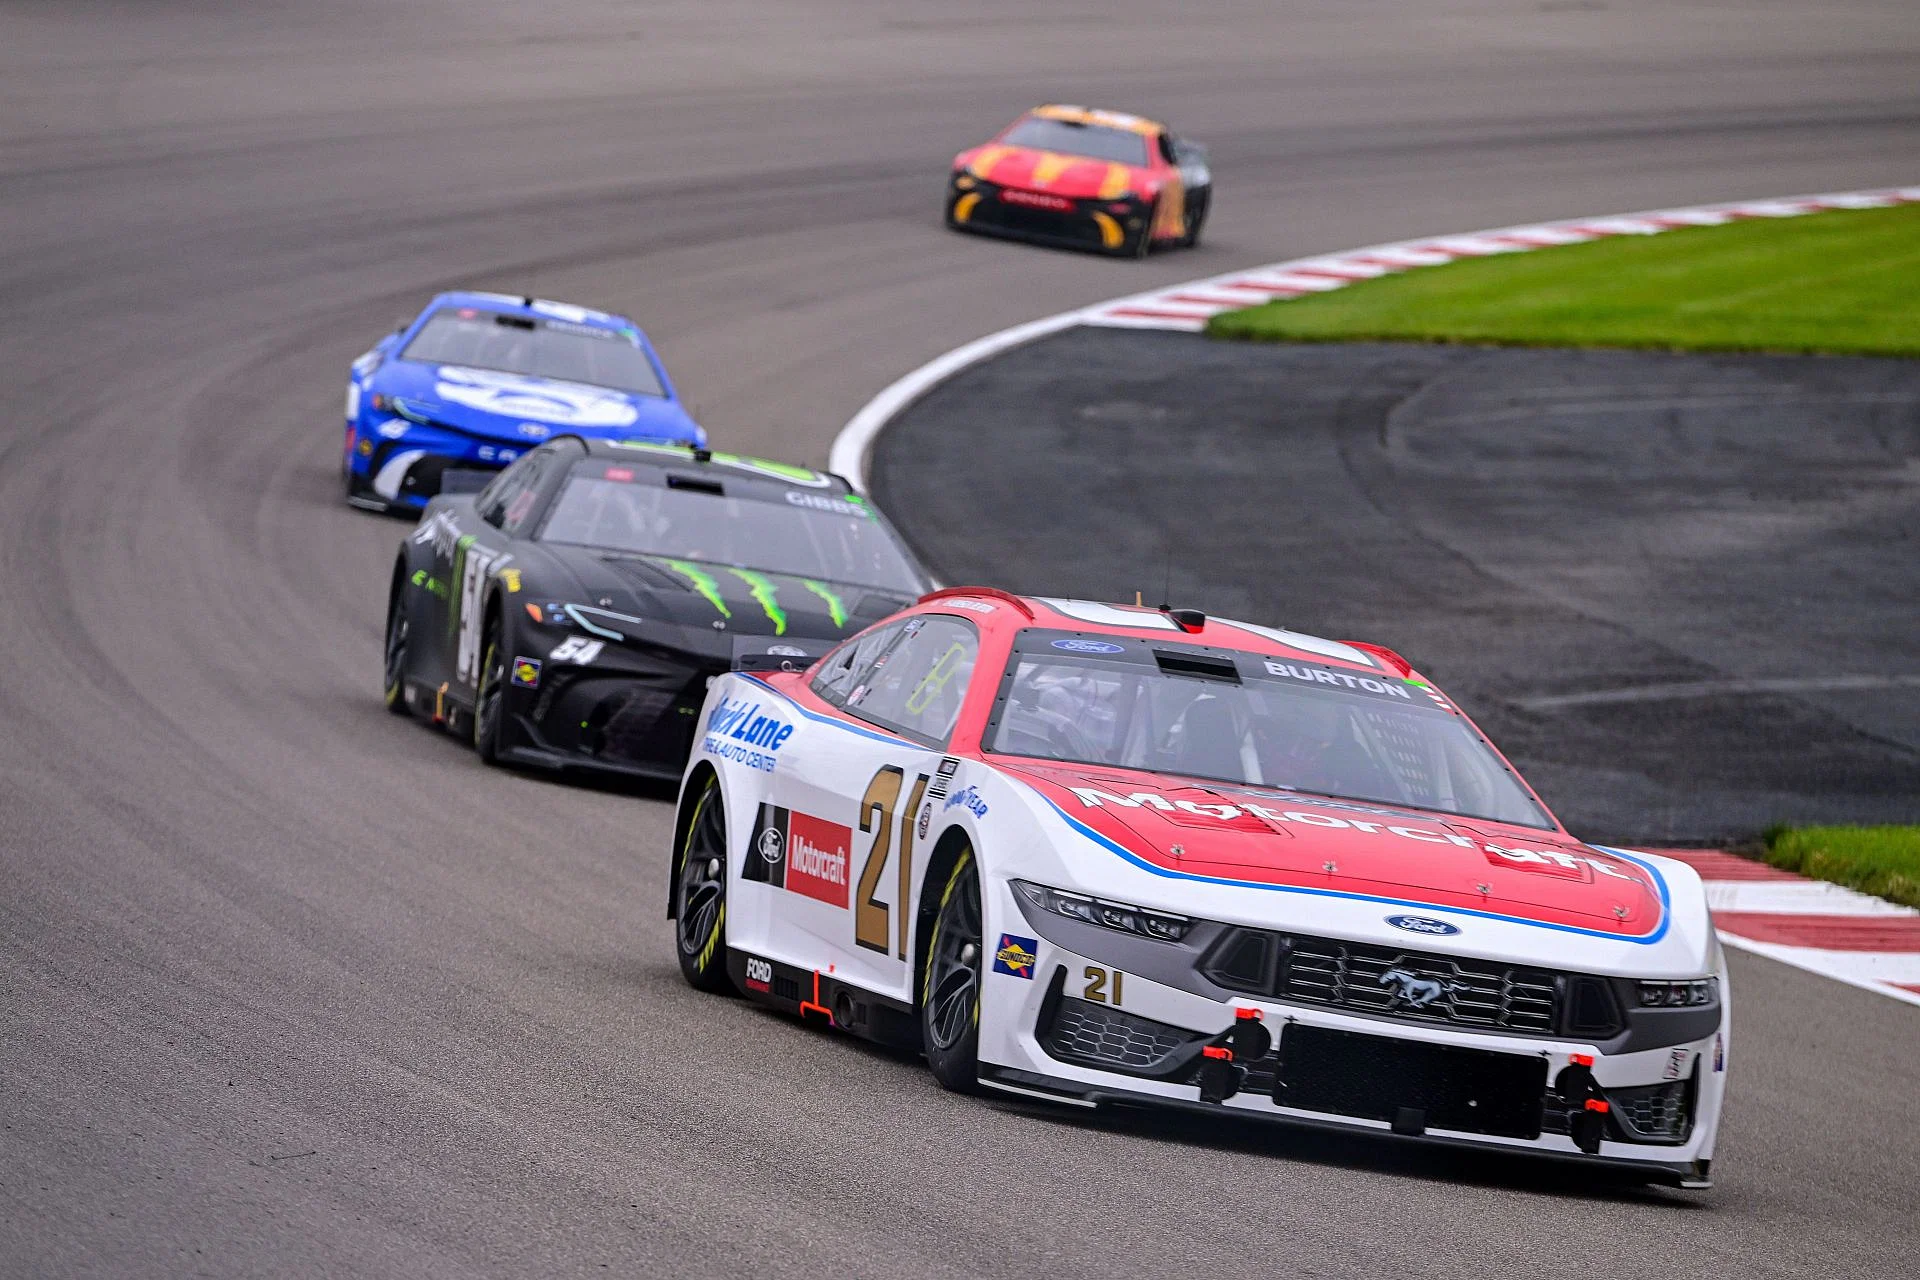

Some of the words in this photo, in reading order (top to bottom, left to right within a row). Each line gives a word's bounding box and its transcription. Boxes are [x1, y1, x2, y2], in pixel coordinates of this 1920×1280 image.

[1263, 661, 1411, 699] BURTON
[731, 704, 793, 750] Lane
[720, 743, 747, 763] AUTO
[746, 752, 776, 772] CENTER
[791, 833, 846, 885] Motorcraft
[856, 763, 930, 962] 21
[746, 957, 772, 983] FORD
[1083, 965, 1122, 1006] 21
